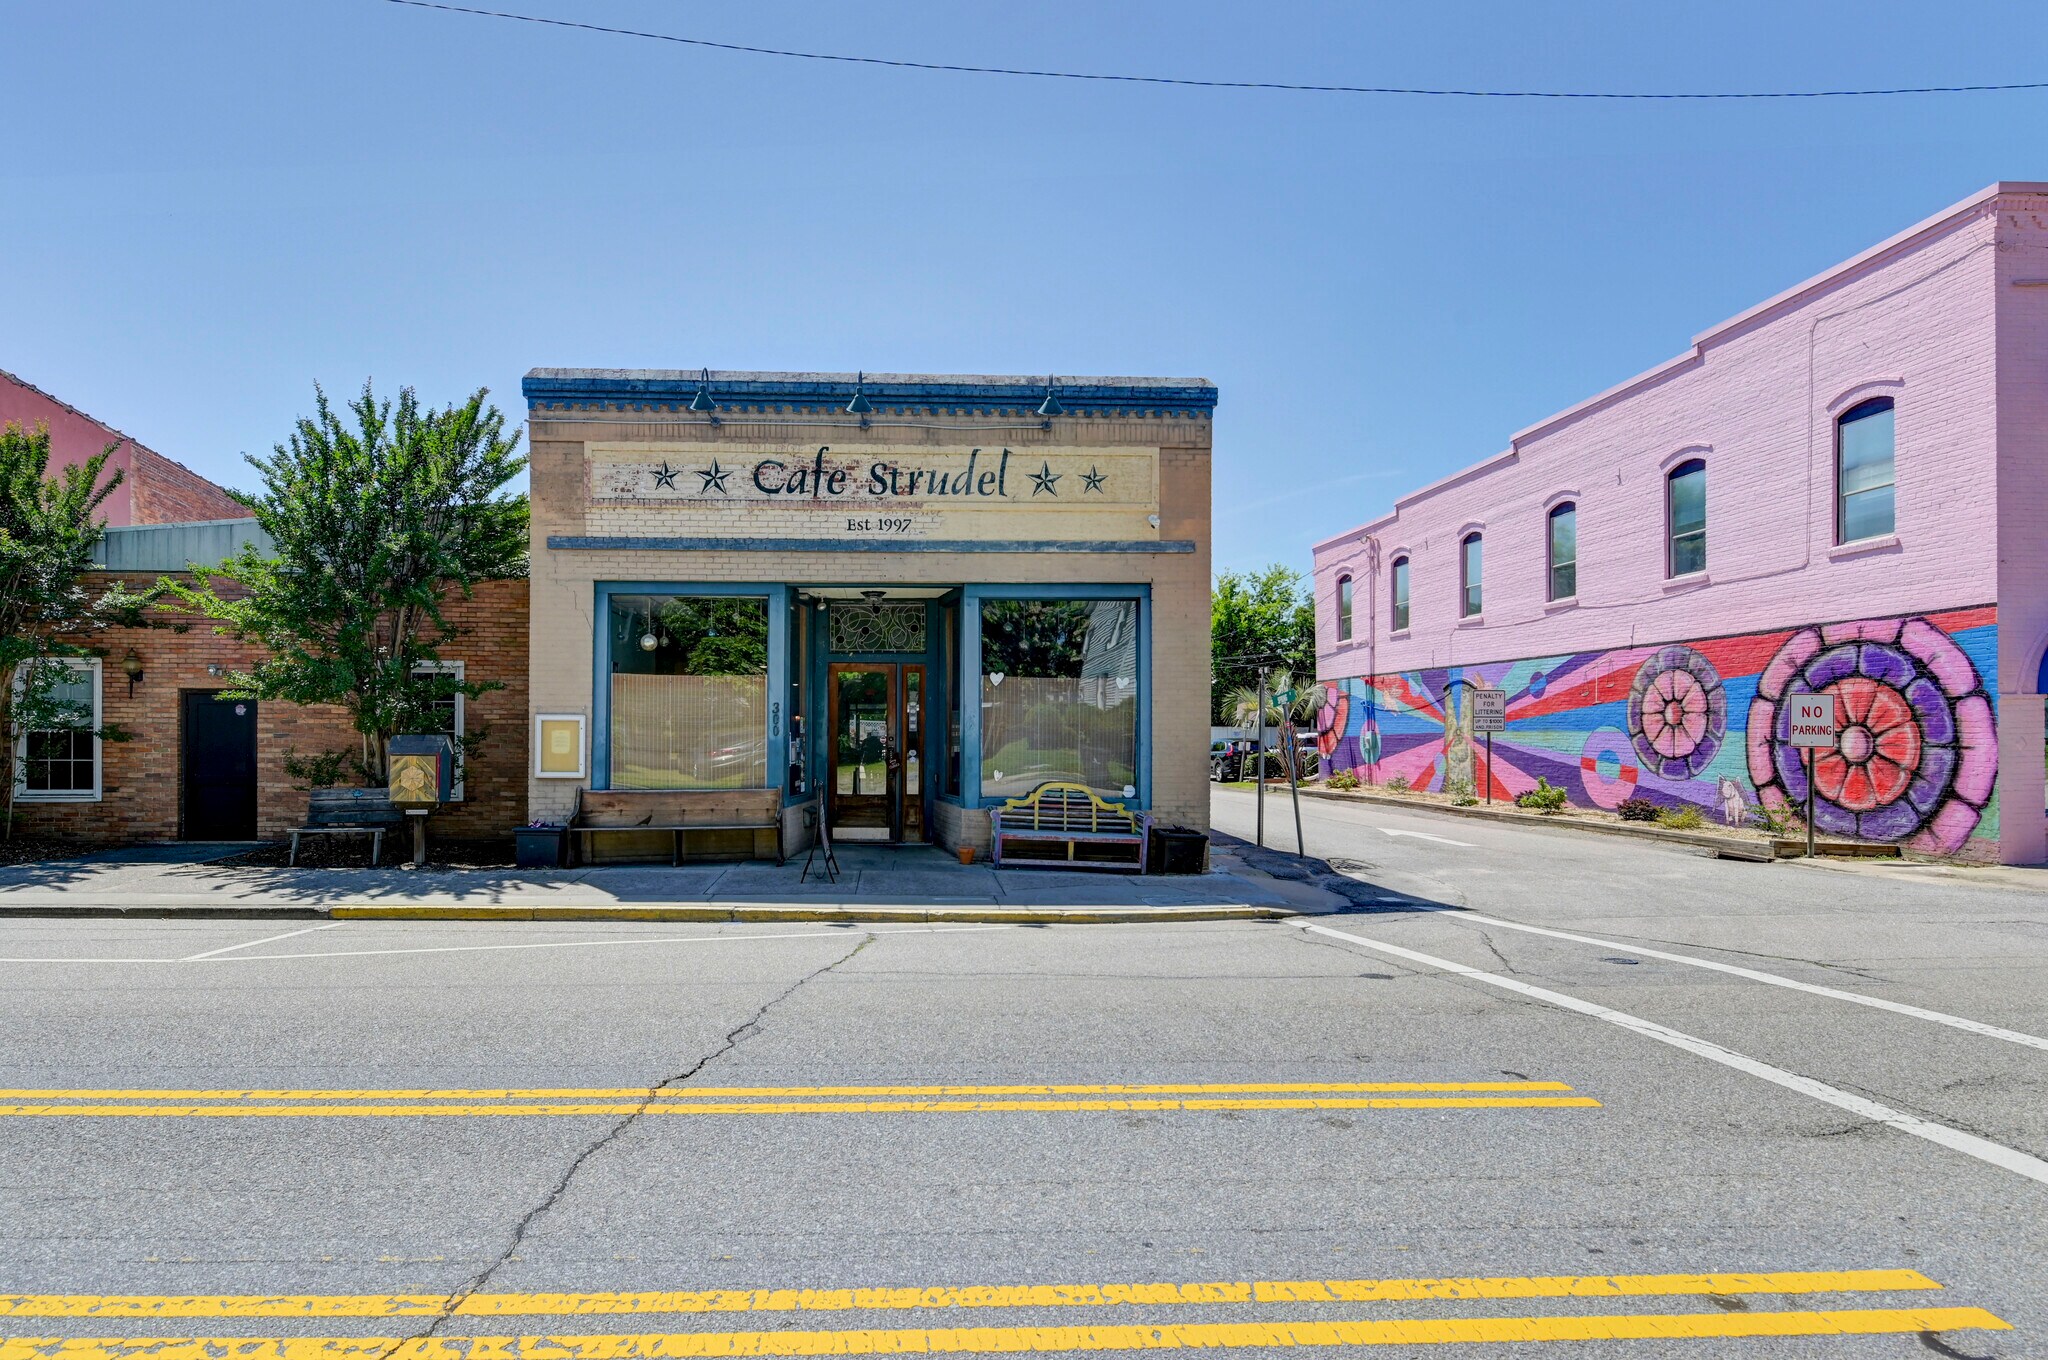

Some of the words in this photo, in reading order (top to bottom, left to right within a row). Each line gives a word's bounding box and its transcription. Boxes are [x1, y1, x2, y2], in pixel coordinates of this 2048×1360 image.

[753, 446, 847, 498] Cafe
[868, 447, 1014, 498] Strudel
[846, 518, 872, 531] Est
[878, 518, 912, 533] 1997
[1801, 706, 1823, 718] NO
[1792, 725, 1832, 736] PARKING
